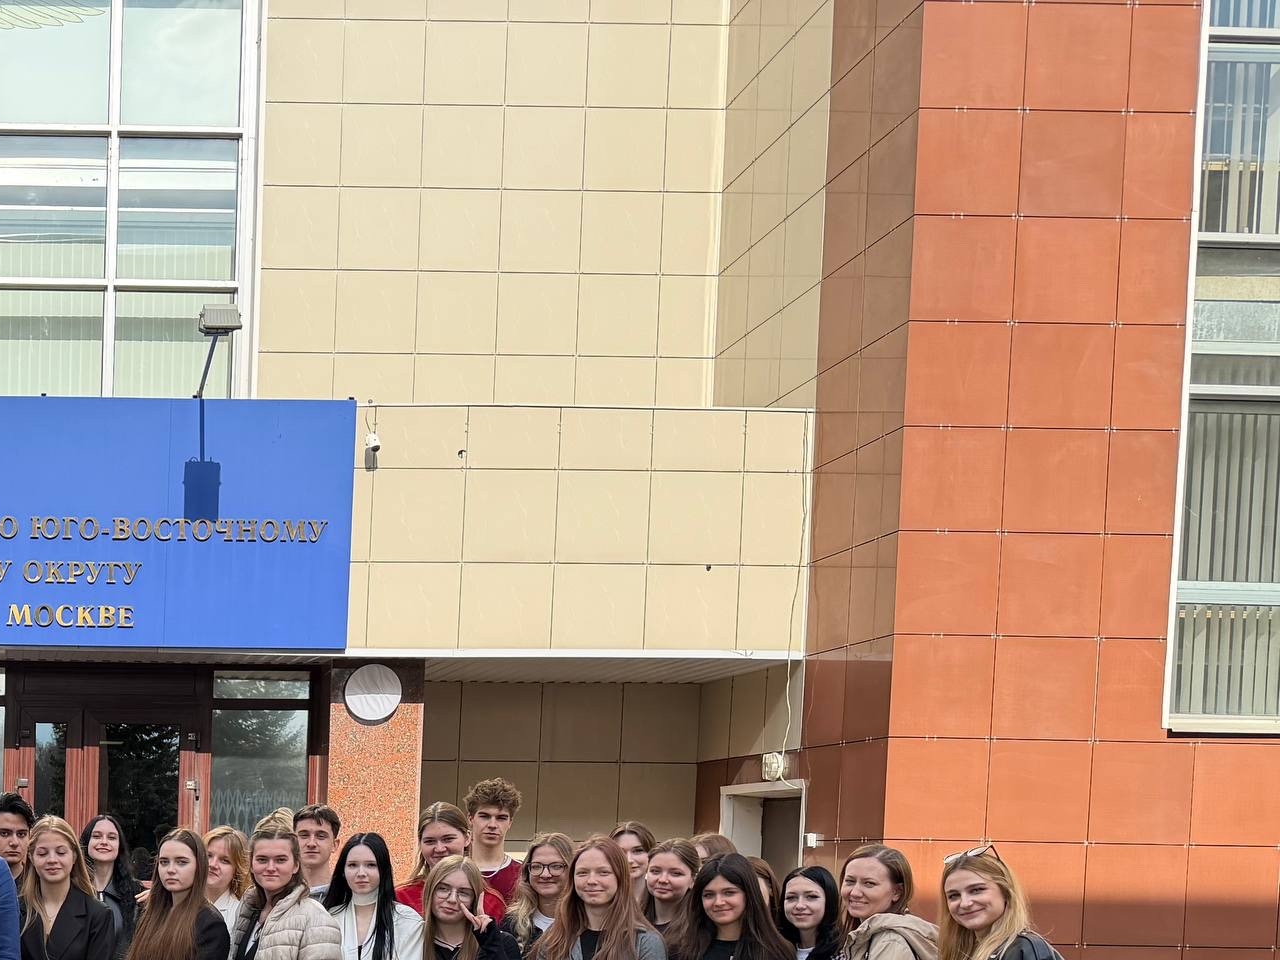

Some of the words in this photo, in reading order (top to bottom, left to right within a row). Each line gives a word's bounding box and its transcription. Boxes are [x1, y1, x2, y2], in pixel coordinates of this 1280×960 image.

[30, 515, 328, 543] ЮГО-ВОСТОЧНОМУ
[23, 559, 142, 585] ОКРУГУ
[6, 604, 135, 628] МОСКВЕ
